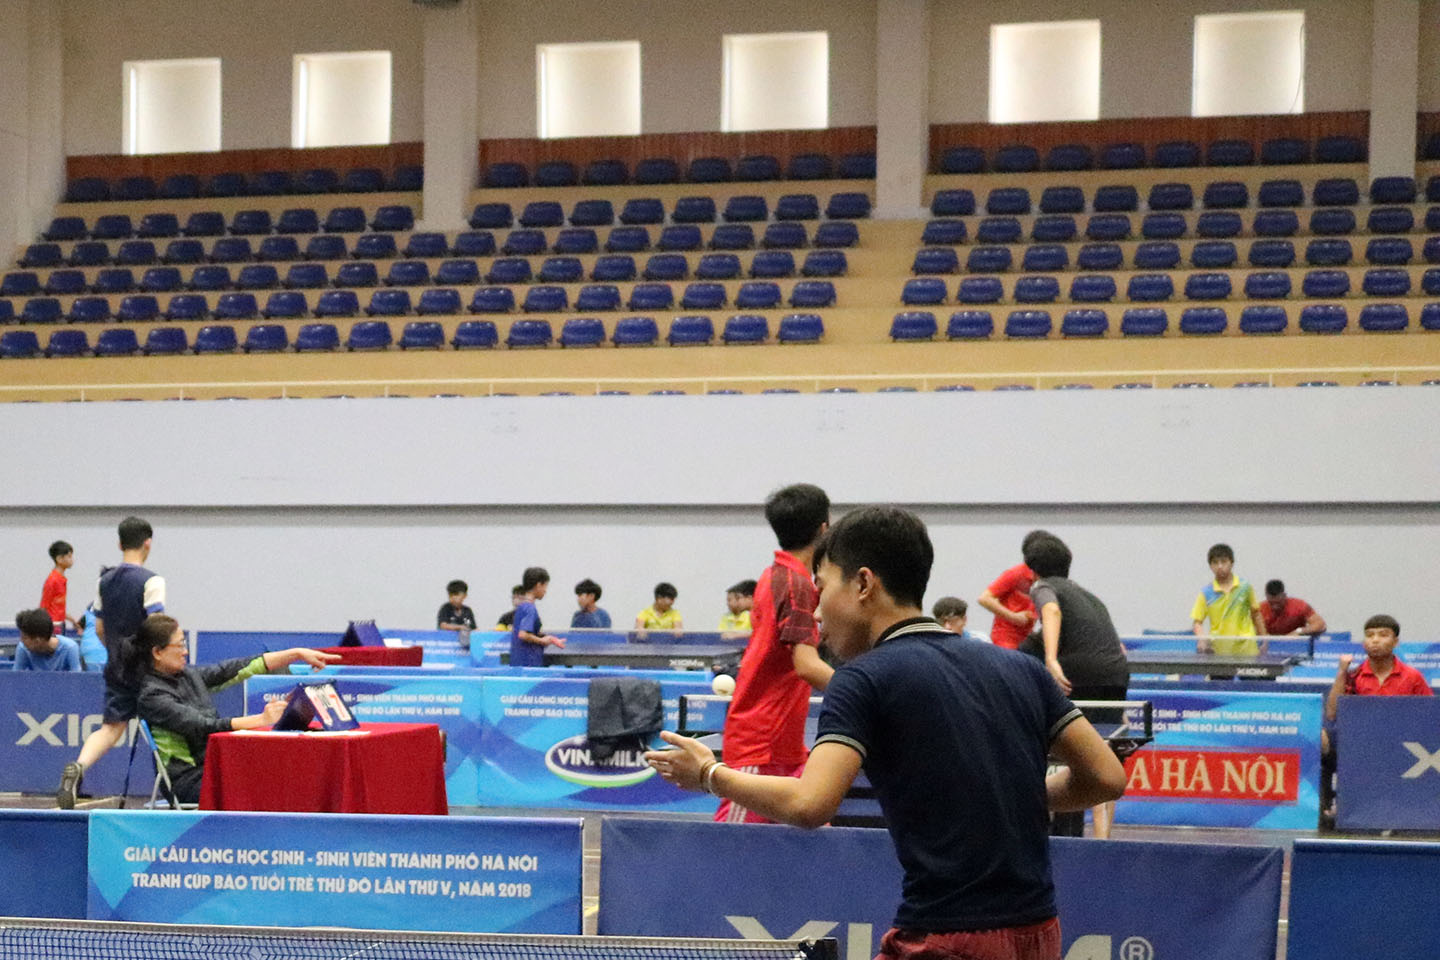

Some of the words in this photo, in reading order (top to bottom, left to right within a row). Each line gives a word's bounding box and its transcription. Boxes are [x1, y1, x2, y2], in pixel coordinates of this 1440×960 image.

[1160, 753, 1213, 792] HÀ
[1221, 754, 1287, 797] NỘI
[271, 849, 305, 866] SINH
[315, 850, 350, 867] SINH
[131, 872, 180, 888] TRANH
[498, 882, 531, 898] 2018
